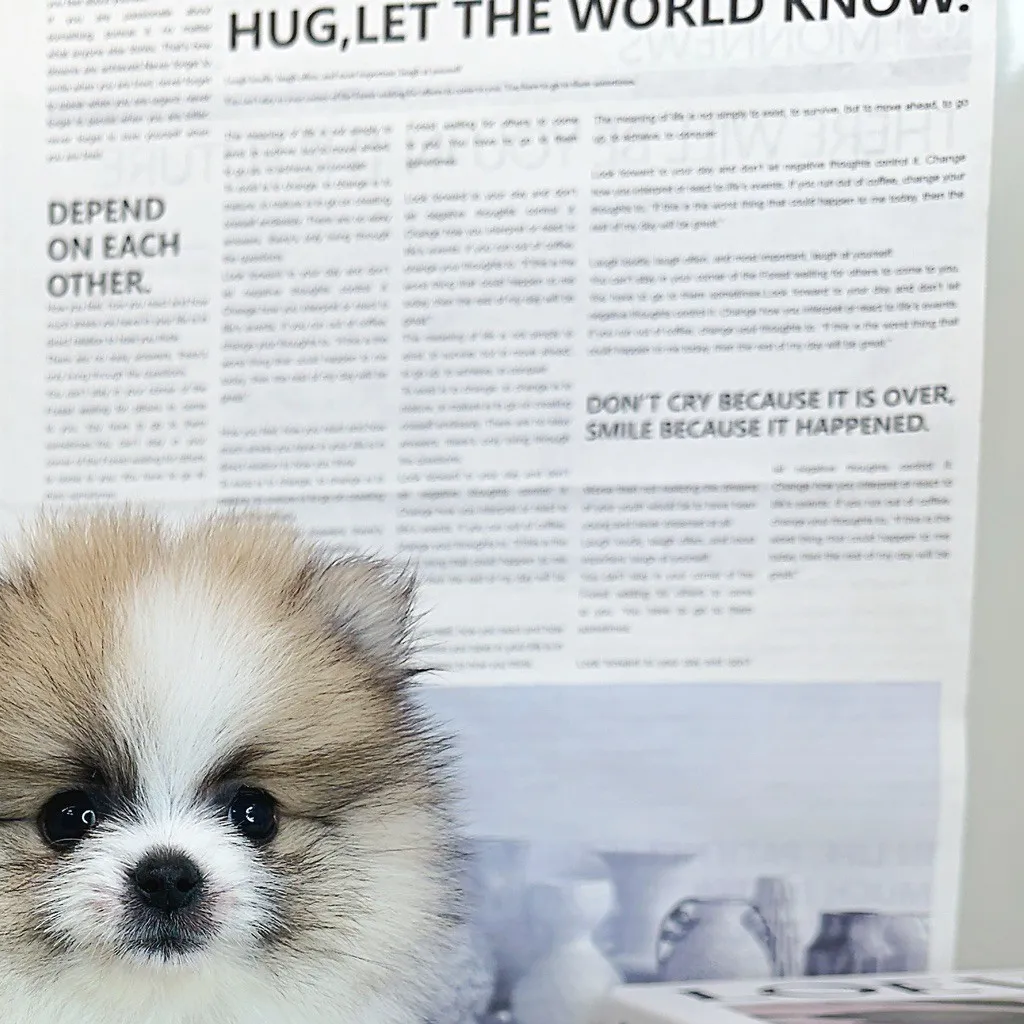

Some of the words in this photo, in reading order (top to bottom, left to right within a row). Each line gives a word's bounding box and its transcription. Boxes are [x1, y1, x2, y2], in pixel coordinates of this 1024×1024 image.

[228, 2, 440, 52] HUG,LET
[453, 0, 551, 39] THE
[573, 0, 764, 32] WORLD
[47, 198, 166, 227] DEPEND
[47, 237, 92, 263] ON
[102, 233, 179, 259] EACH
[47, 270, 152, 298] OTHER.
[586, 391, 660, 415] DON'T
[666, 390, 711, 413] CRY
[718, 387, 821, 412] BECAUSE
[827, 387, 851, 409] IT
[855, 386, 877, 409] IS
[882, 384, 956, 408] OVER,
[584, 419, 652, 442] SMILE
[659, 416, 762, 440] BECAUSE
[766, 415, 791, 438] IT
[795, 413, 930, 437] HAPPENED.
